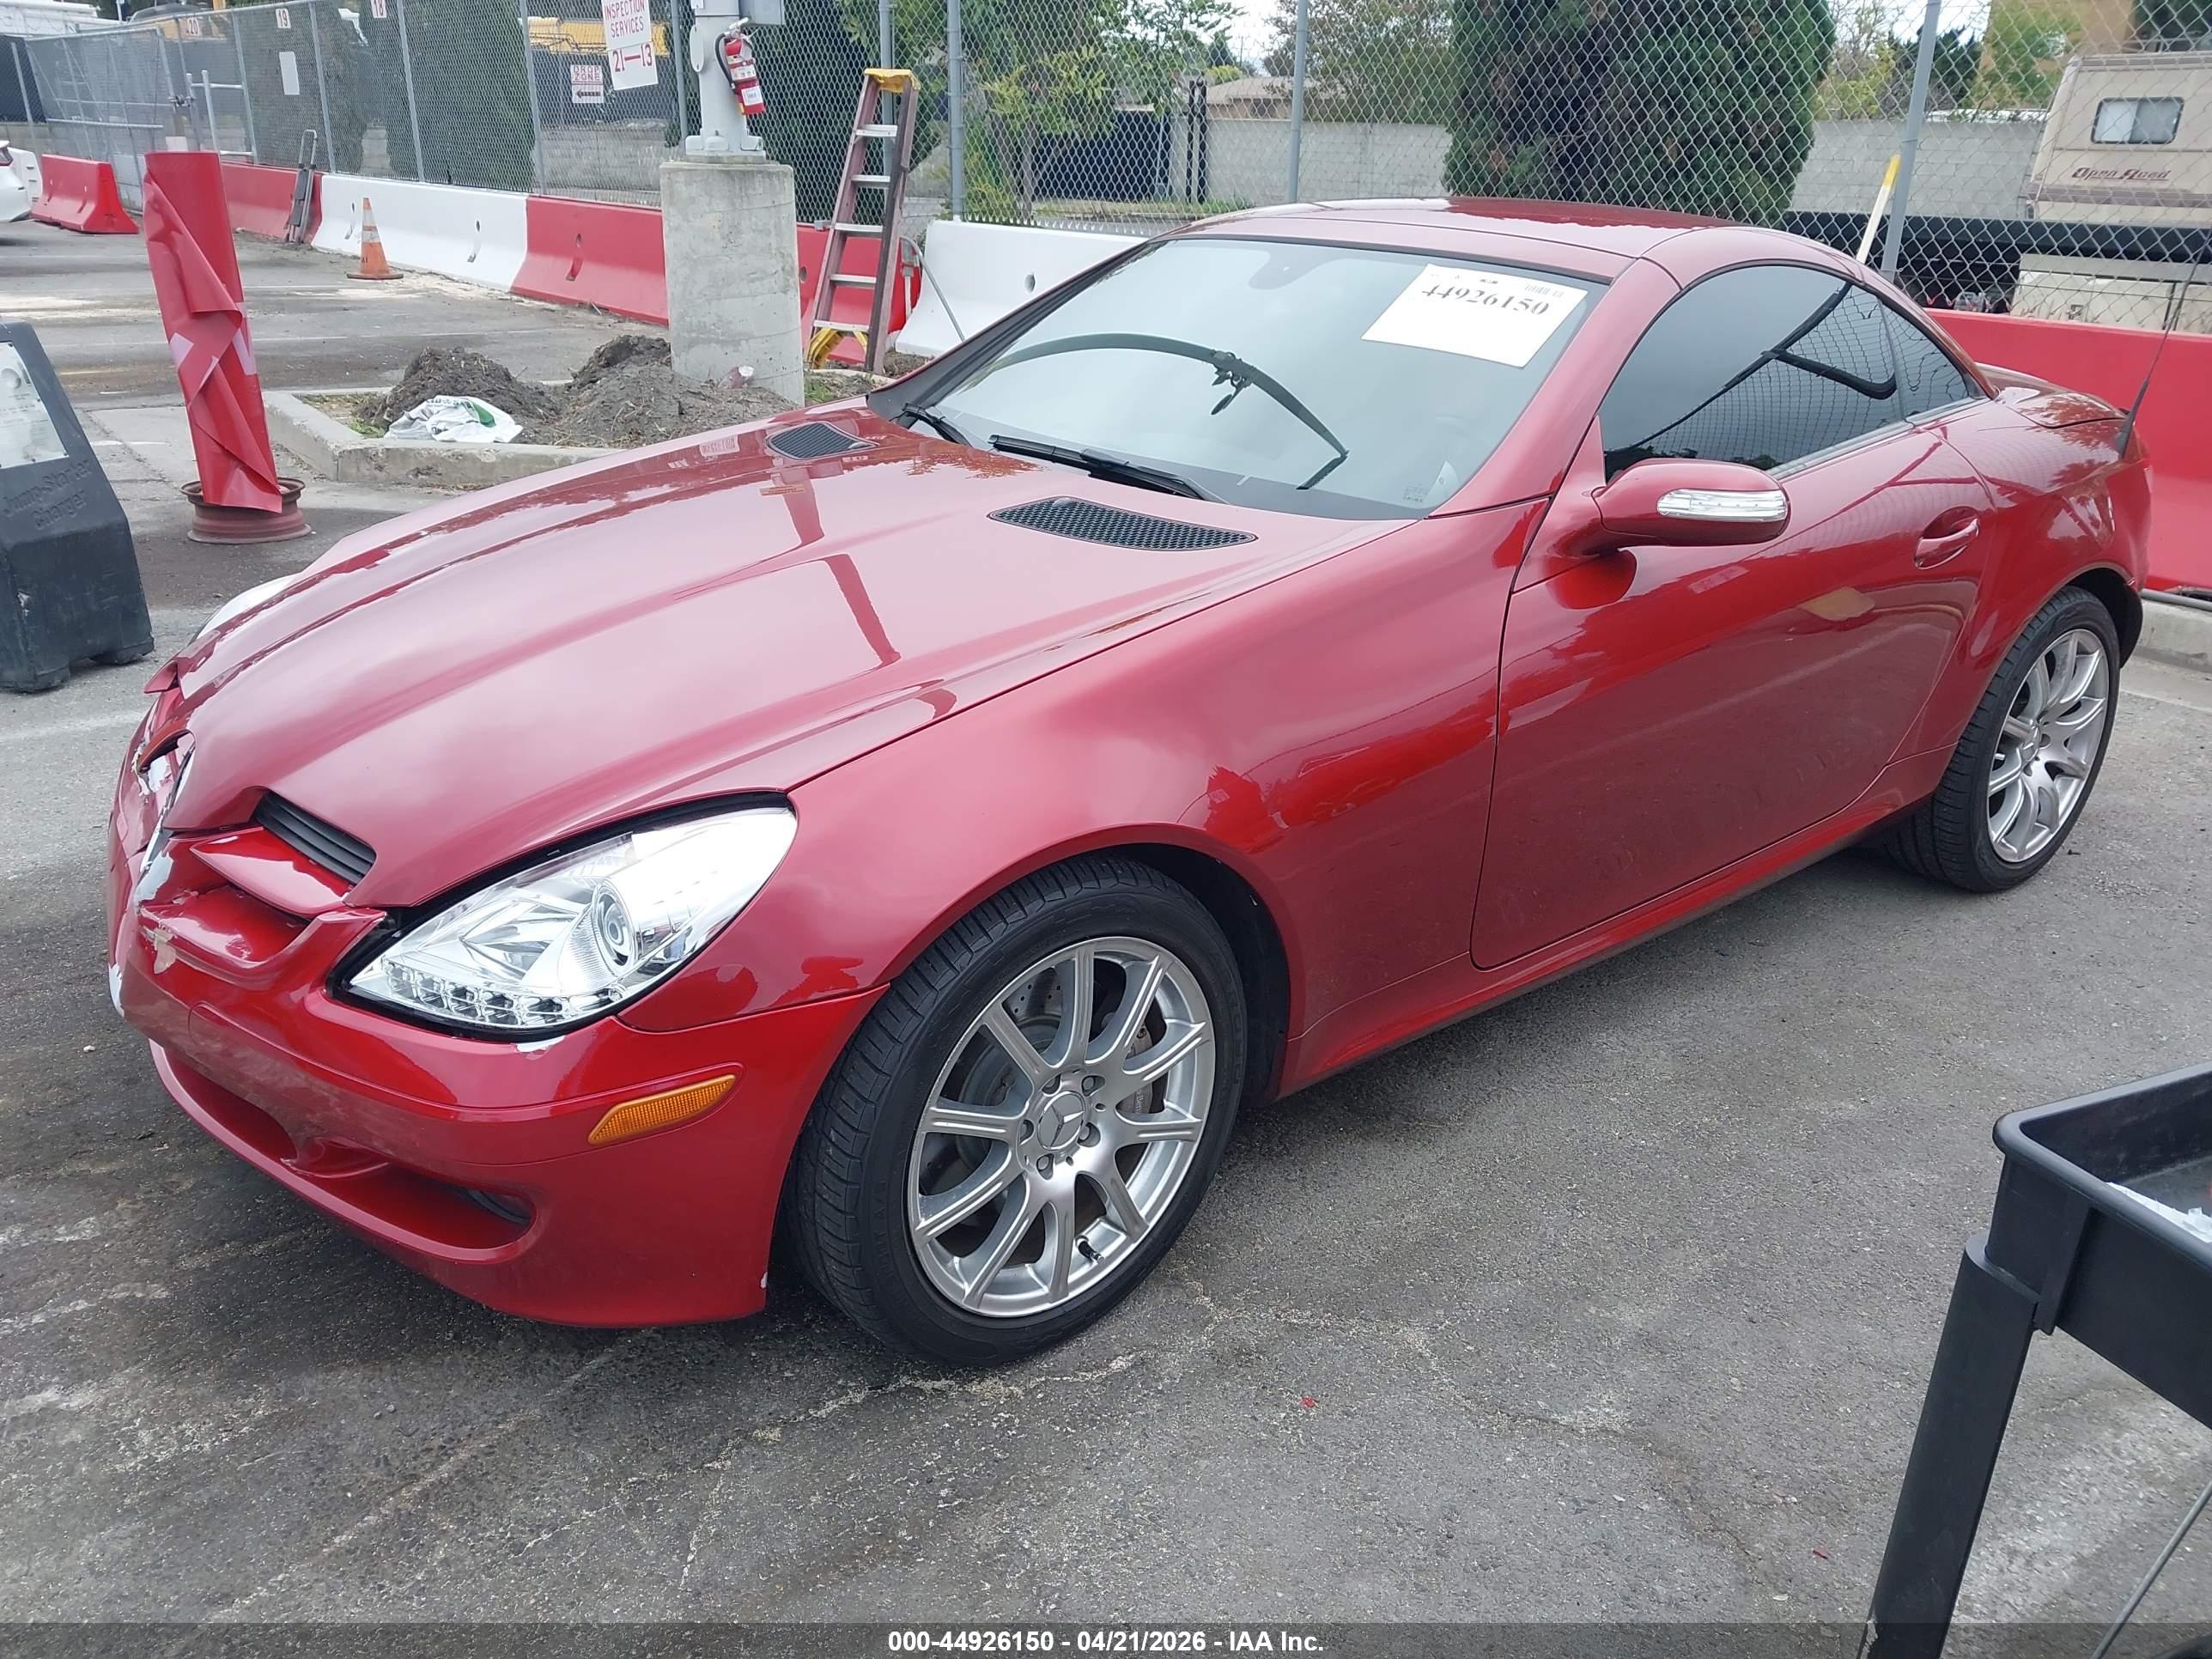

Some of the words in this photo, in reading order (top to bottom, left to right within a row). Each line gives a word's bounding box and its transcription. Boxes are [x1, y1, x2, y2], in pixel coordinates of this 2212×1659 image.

[278, 9, 288, 27] 19
[604, 0, 646, 21] INSPECTION
[611, 15, 644, 39] SERVICES
[574, 73, 600, 82] ZONE
[1421, 284, 1549, 315] 44926150
